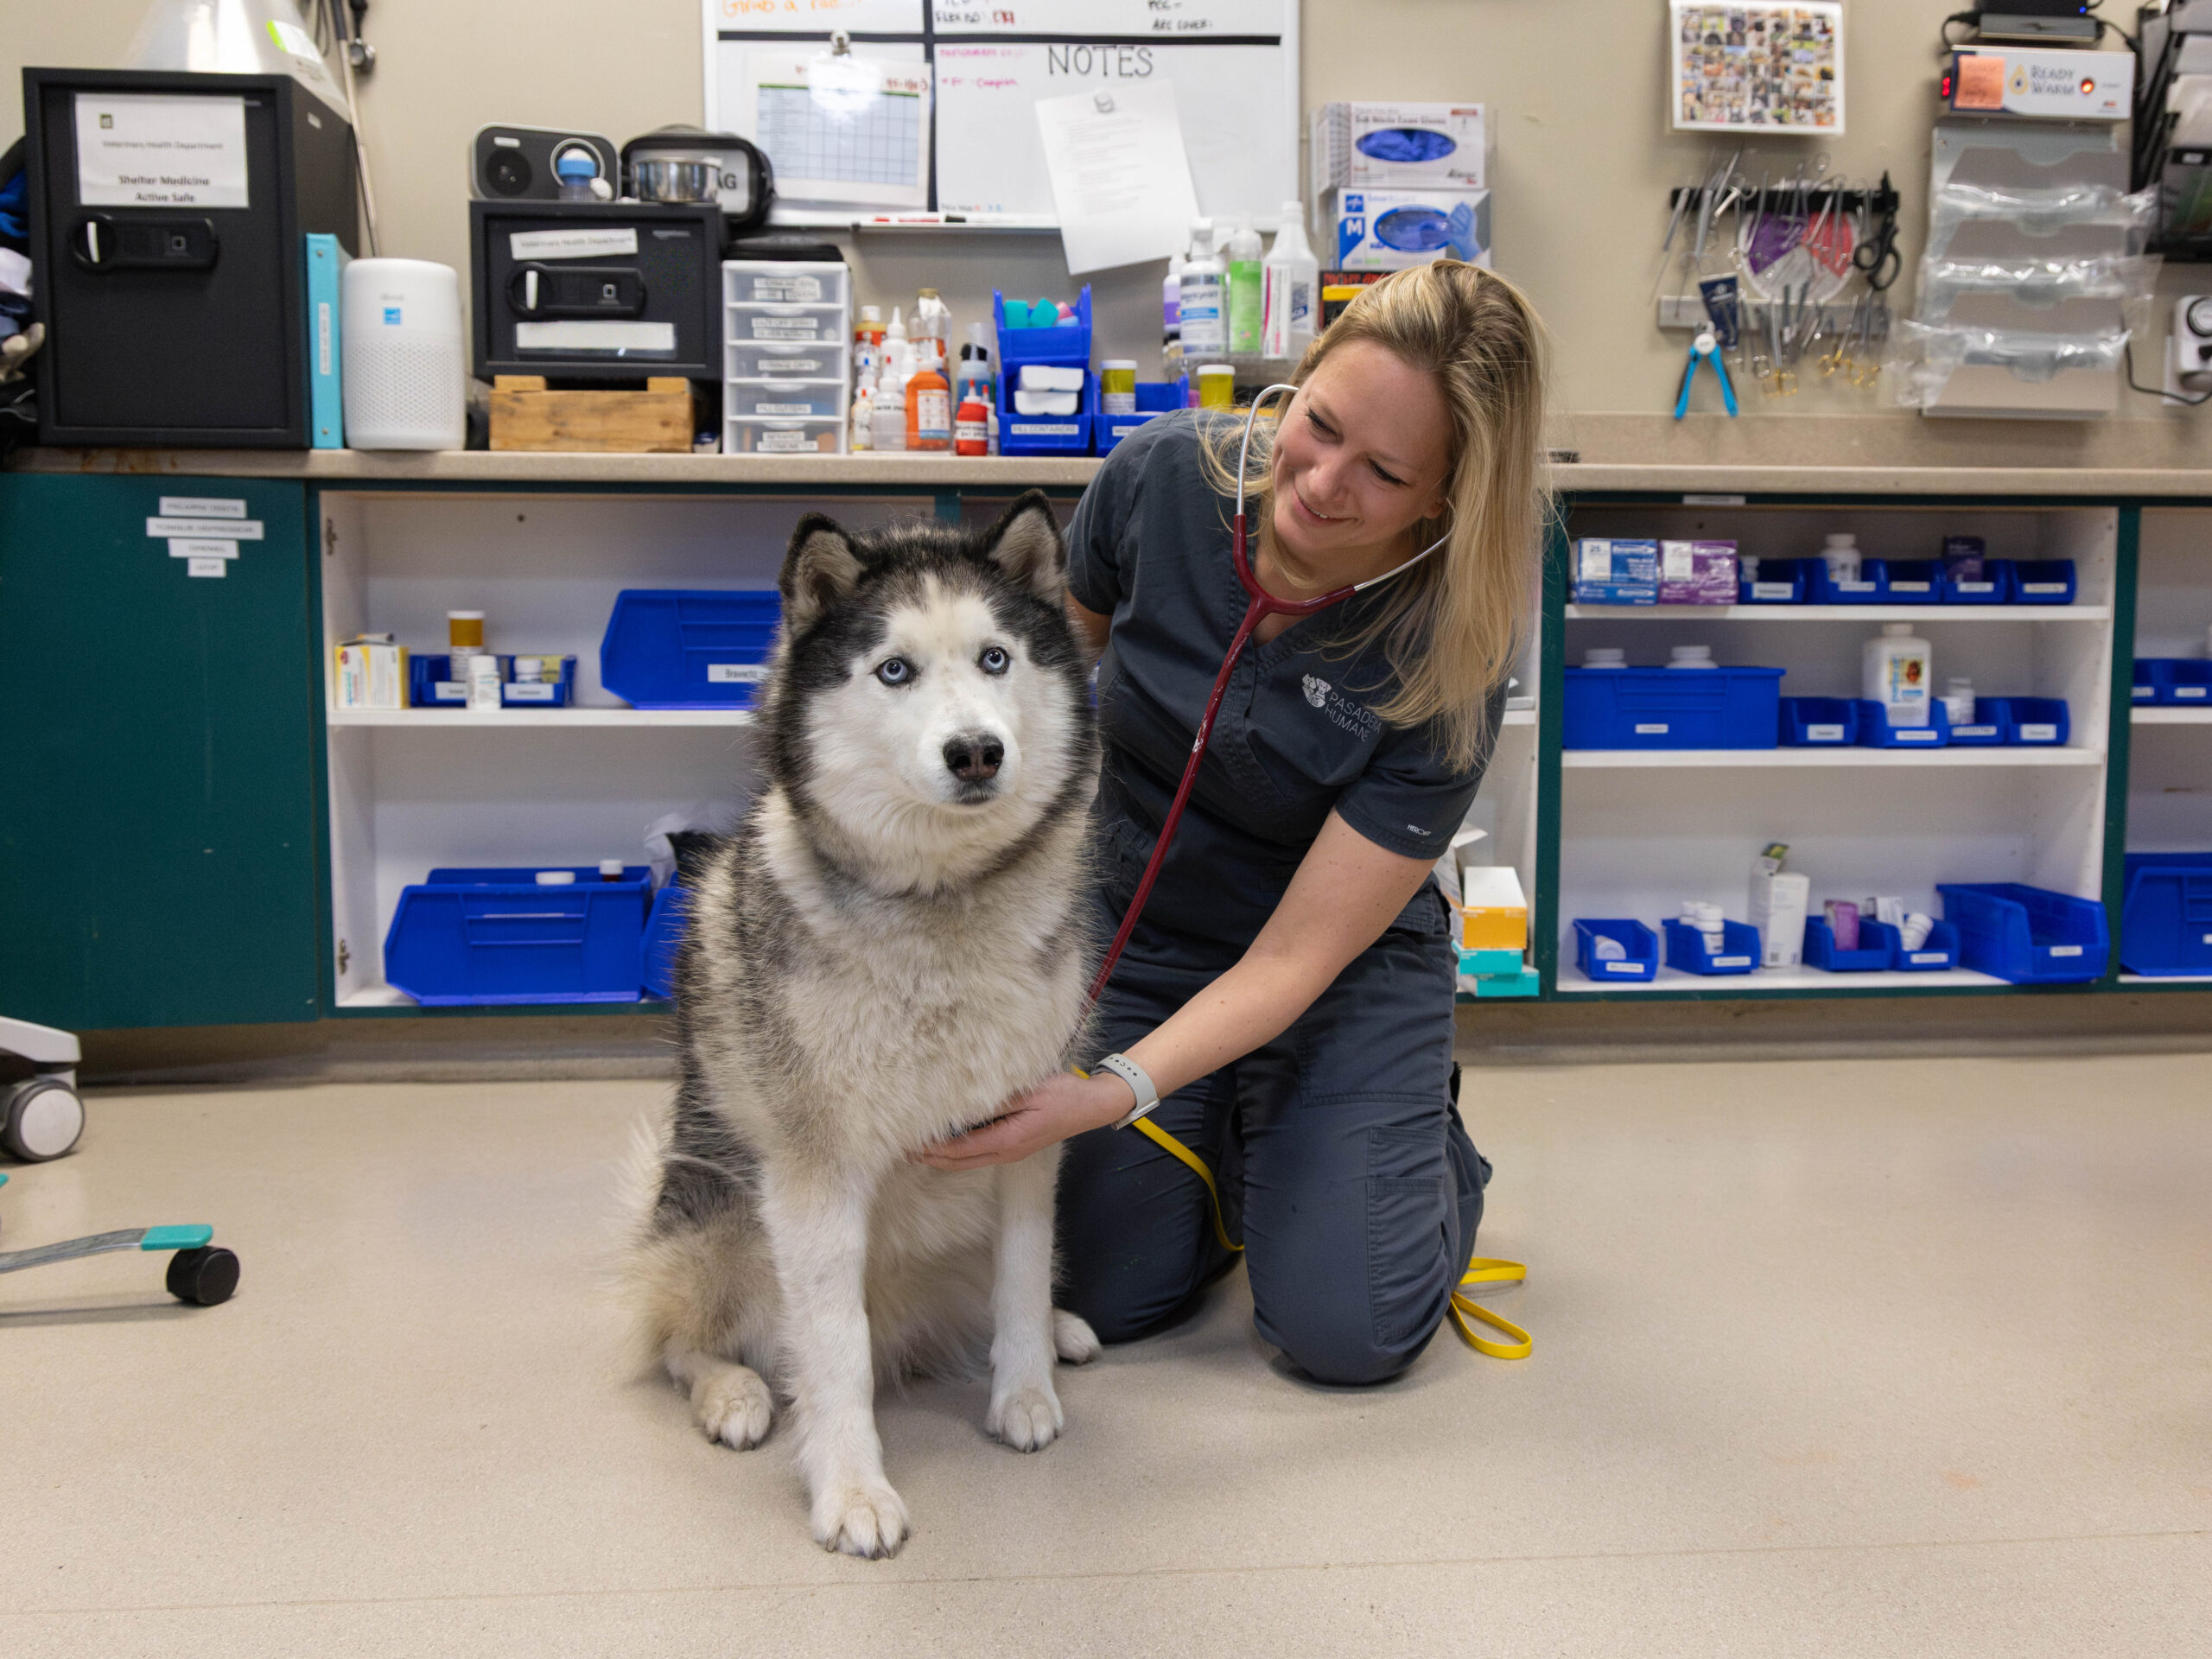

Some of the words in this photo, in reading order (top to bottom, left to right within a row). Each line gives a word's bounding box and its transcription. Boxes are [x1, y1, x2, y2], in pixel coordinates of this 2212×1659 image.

[1047, 44, 1154, 78] NOTES
[2031, 64, 2074, 79] READY
[2031, 79, 2075, 94] WARM
[175, 142, 224, 150] Department
[118, 175, 157, 186] Shelter
[160, 176, 210, 186] Medicine
[135, 193, 168, 202] Active
[172, 193, 195, 202] Safe
[1346, 219, 1363, 236] M
[725, 668, 758, 678] Bravecto
[1329, 691, 1382, 735] PASADENA
